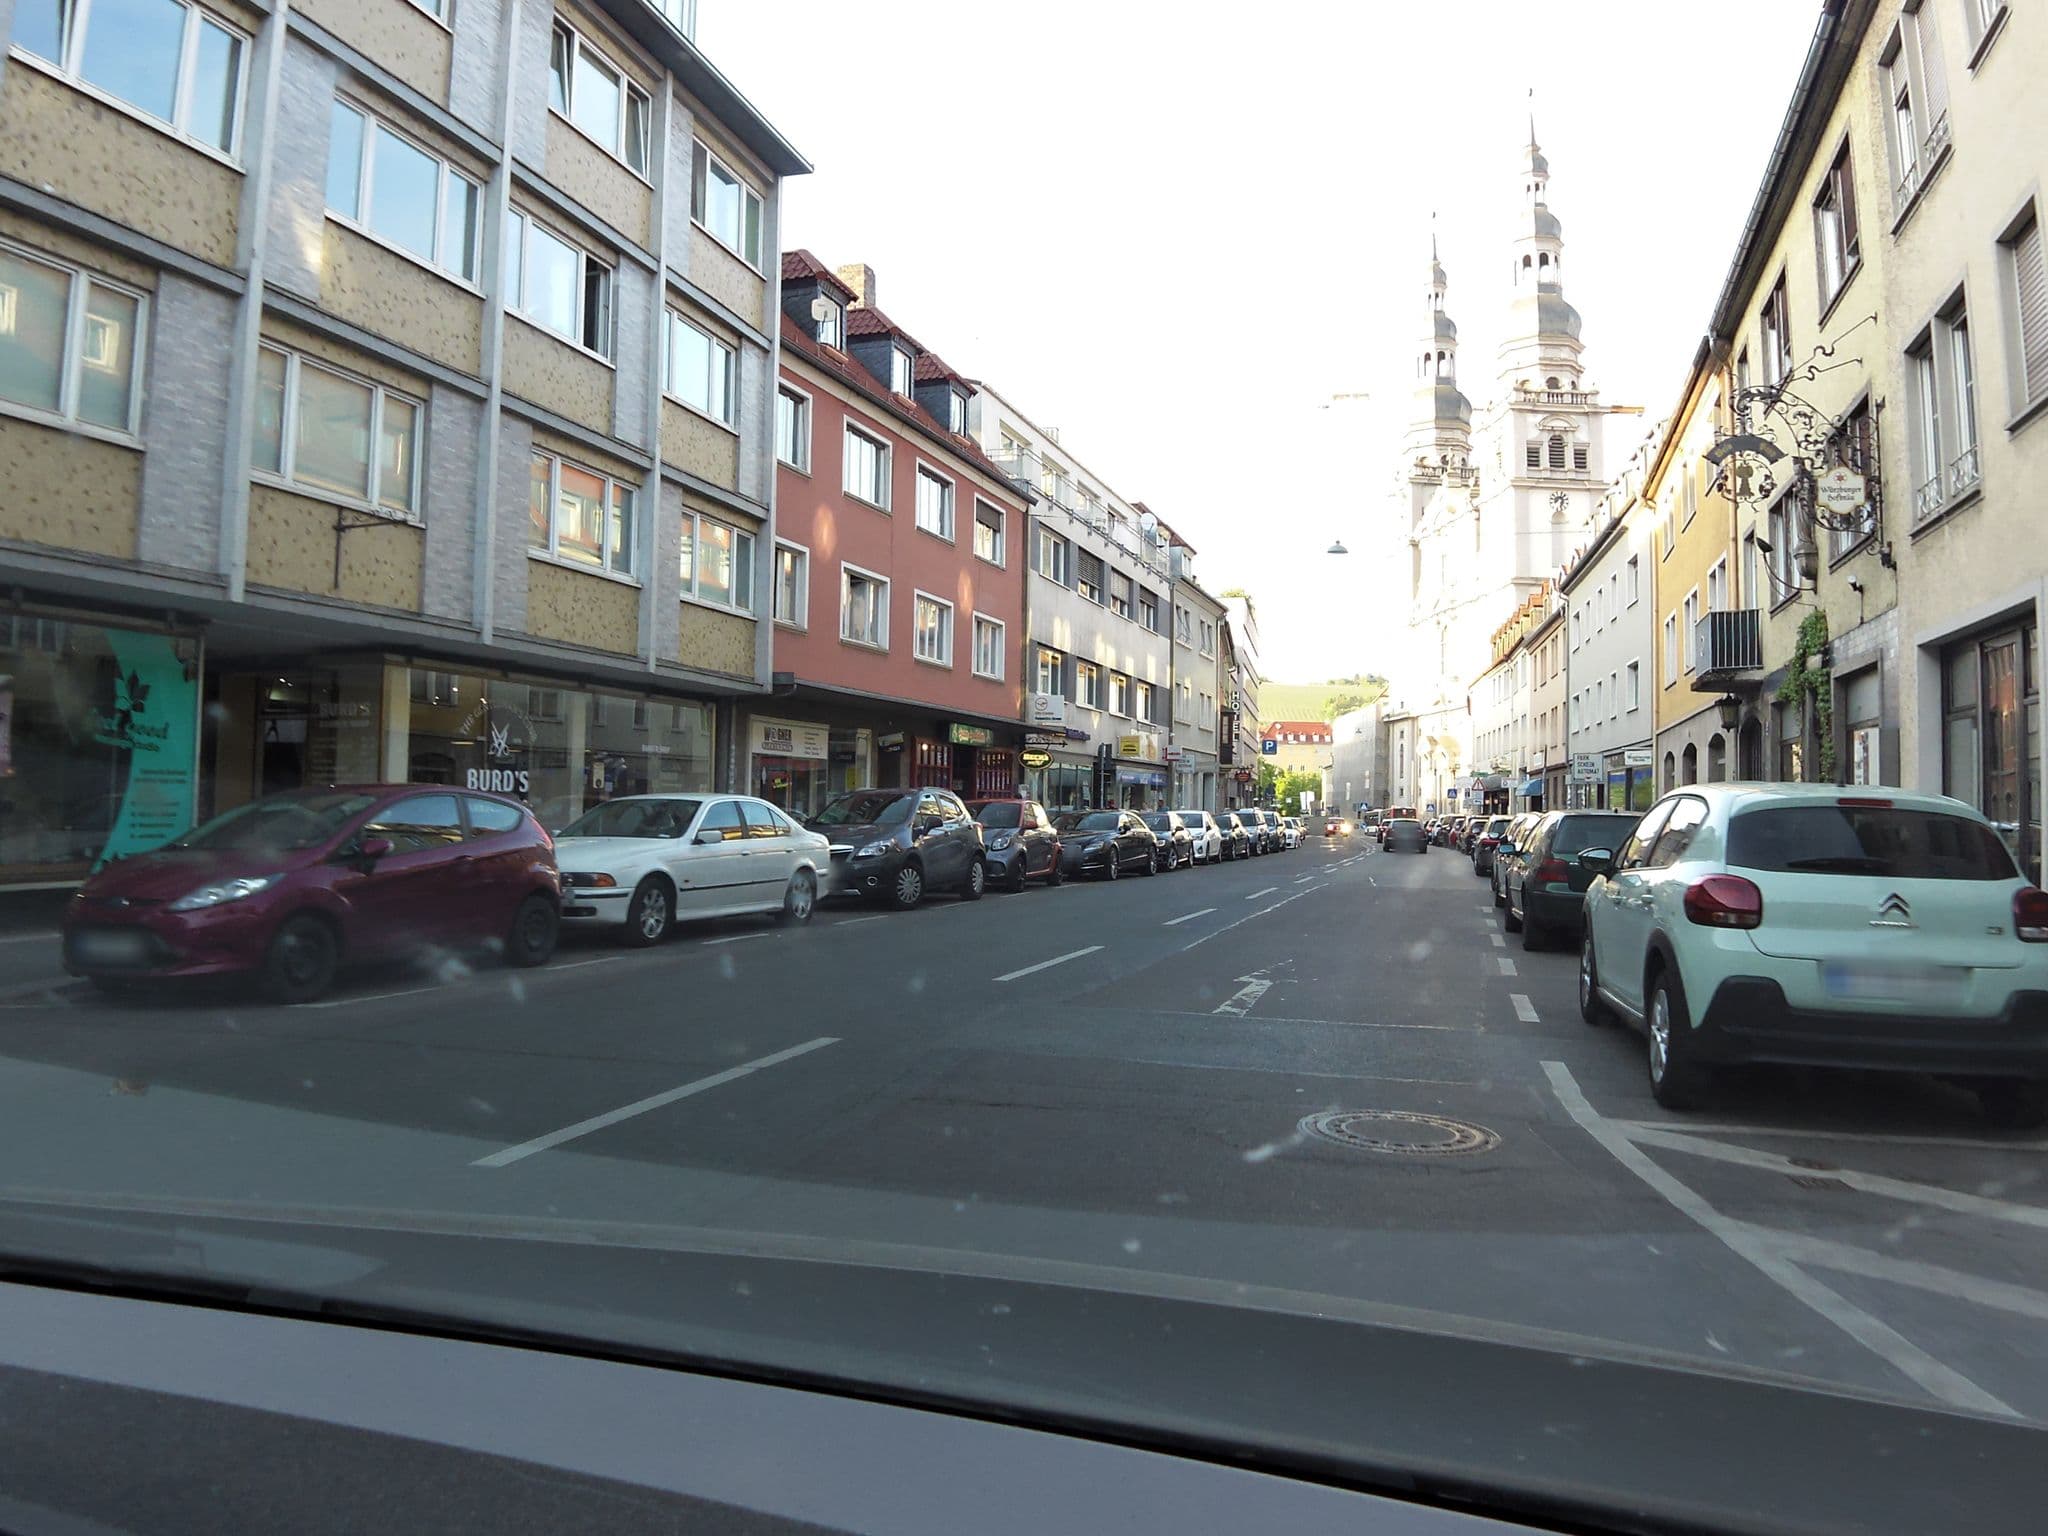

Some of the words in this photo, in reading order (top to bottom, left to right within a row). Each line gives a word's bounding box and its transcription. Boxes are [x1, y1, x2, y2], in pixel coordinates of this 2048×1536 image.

[1232, 690, 1240, 742] HOTEL
[1266, 741, 1274, 750] P
[467, 768, 529, 792] BURD'S
